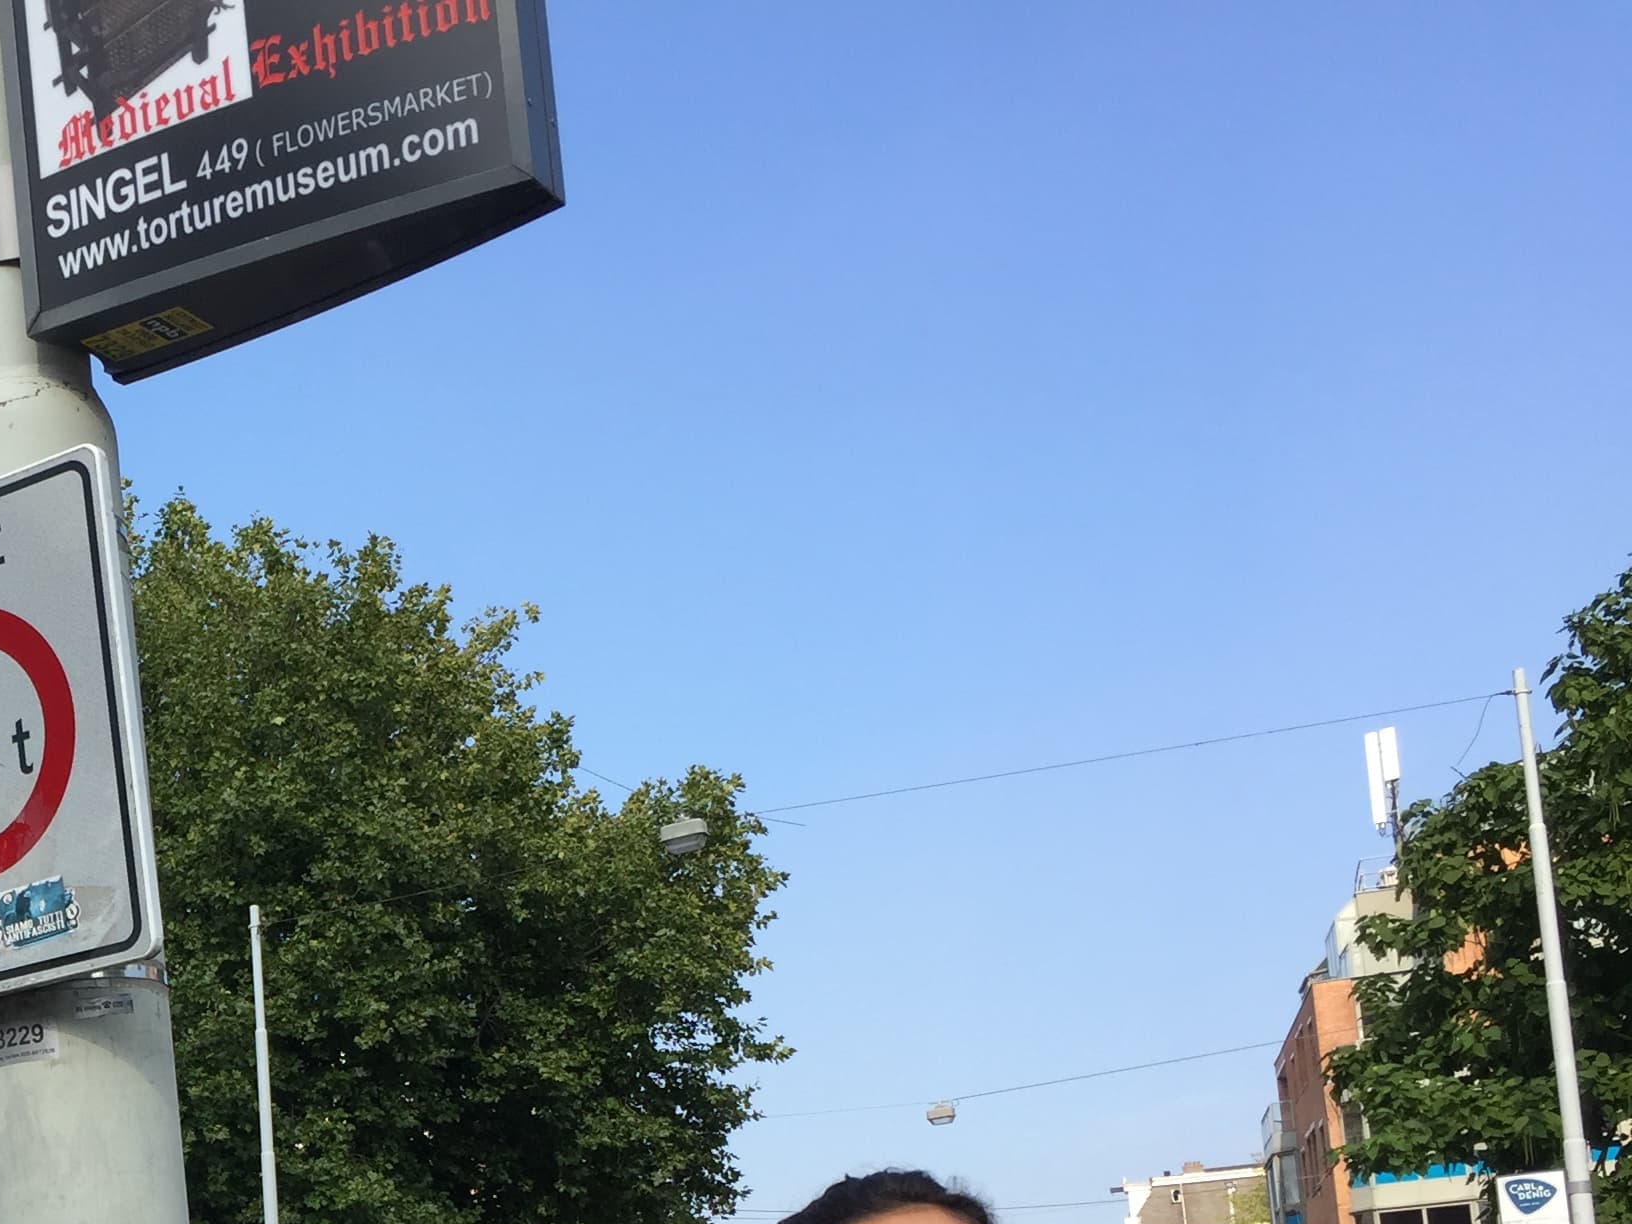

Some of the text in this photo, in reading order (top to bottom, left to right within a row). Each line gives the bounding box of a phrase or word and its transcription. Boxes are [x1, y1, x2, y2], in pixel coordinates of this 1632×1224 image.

[57, 56, 236, 168] Medieval
[46, 152, 187, 239] SINGEL
[195, 137, 249, 181] 449
[58, 117, 479, 279] www.torturemuseum.com
